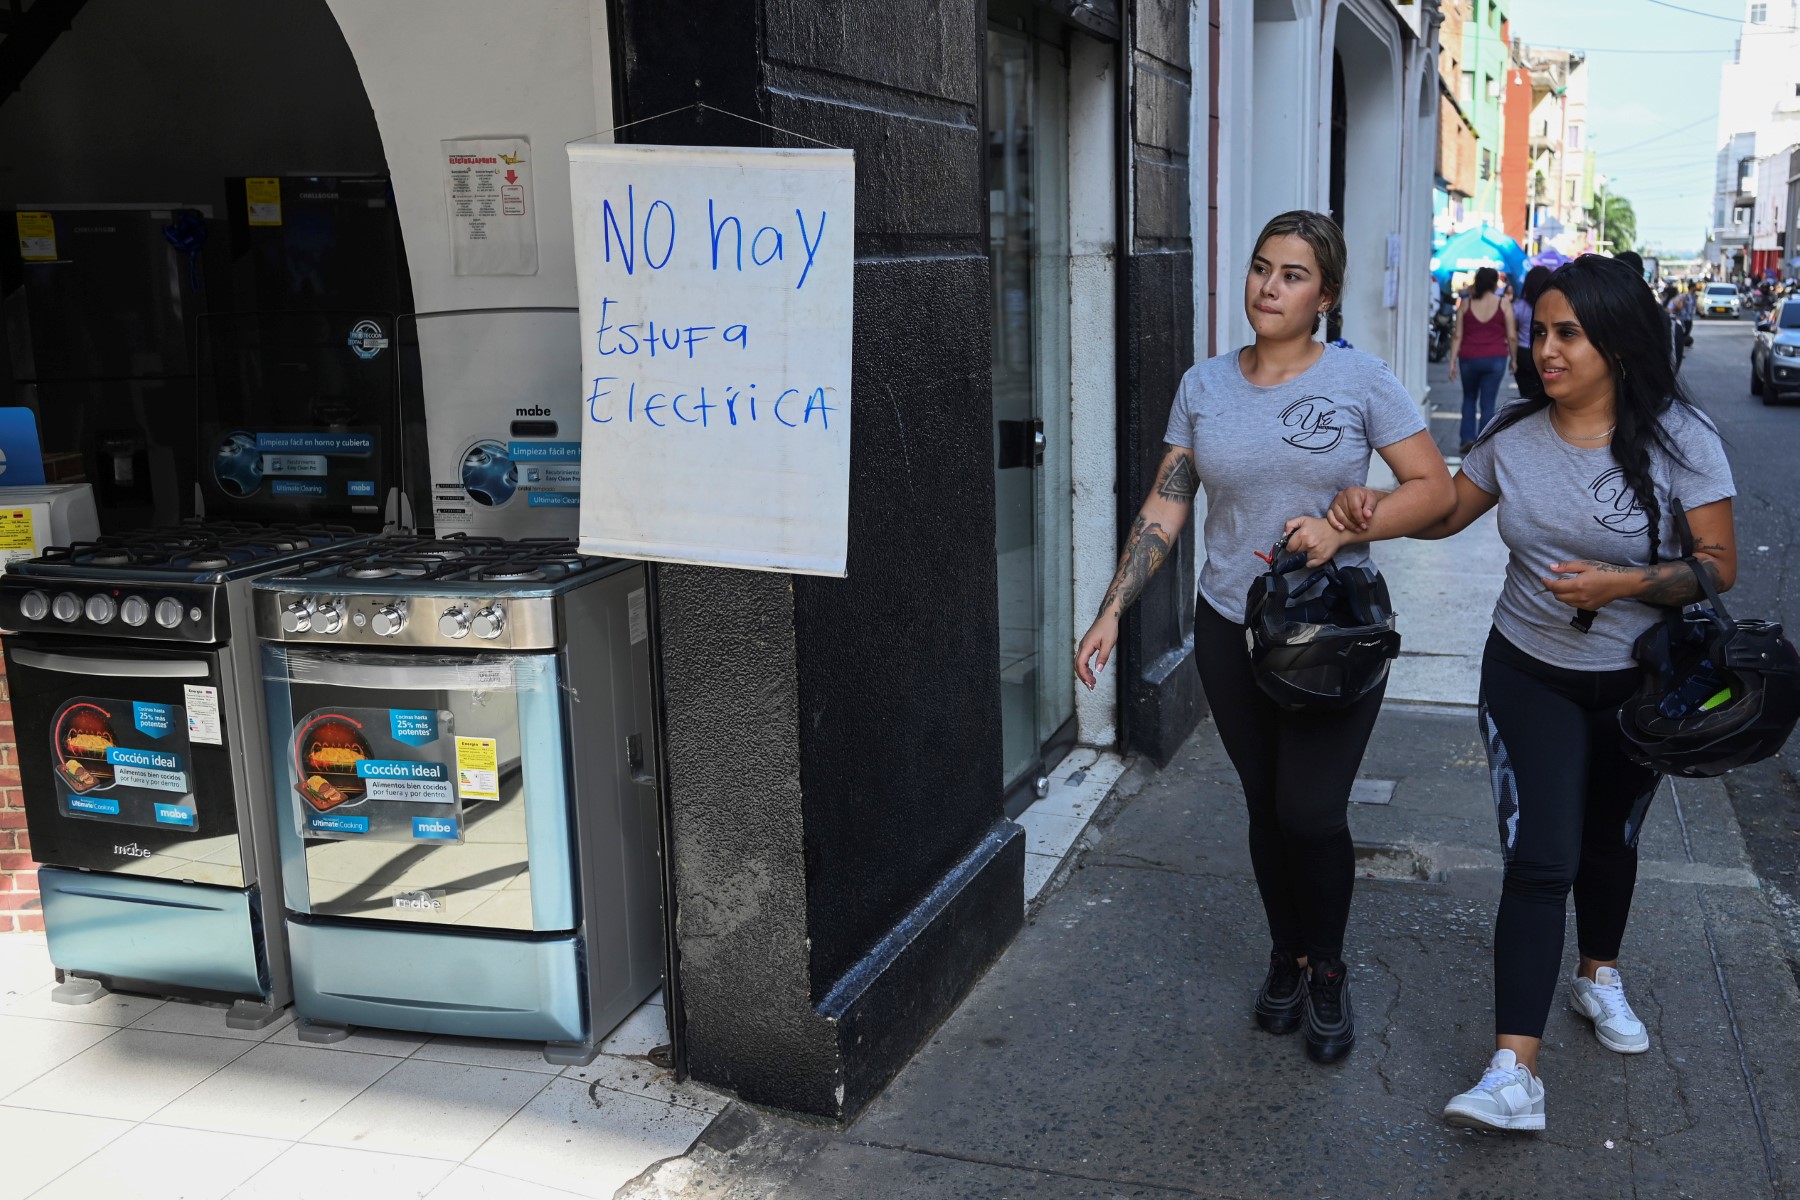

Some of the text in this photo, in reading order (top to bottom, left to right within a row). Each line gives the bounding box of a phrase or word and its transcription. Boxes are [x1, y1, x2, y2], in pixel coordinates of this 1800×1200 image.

[708, 198, 826, 289] hay
[516, 404, 551, 416] mabe
[260, 438, 289, 448] Limpieza
[290, 438, 304, 446] fácil
[314, 438, 335, 446] horno
[335, 440, 340, 448] y
[342, 438, 370, 447] cubierta
[513, 448, 547, 456] Limpieza
[549, 447, 564, 455] fácil
[300, 485, 322, 493] Cleaning
[139, 712, 154, 722] 25%
[397, 720, 413, 728] 25%
[113, 750, 176, 768] Cocción ideal
[120, 768, 147, 777] Alimentos
[364, 764, 441, 777] Cocción ideal
[372, 781, 406, 789] Alimentos
[72, 800, 94, 809] Ultimate
[94, 803, 115, 812] Cooking
[160, 808, 188, 820] mabe
[339, 821, 363, 830] Cooking
[419, 821, 451, 833] mabe
[114, 842, 151, 858] mabe
[395, 895, 441, 910] mabe
